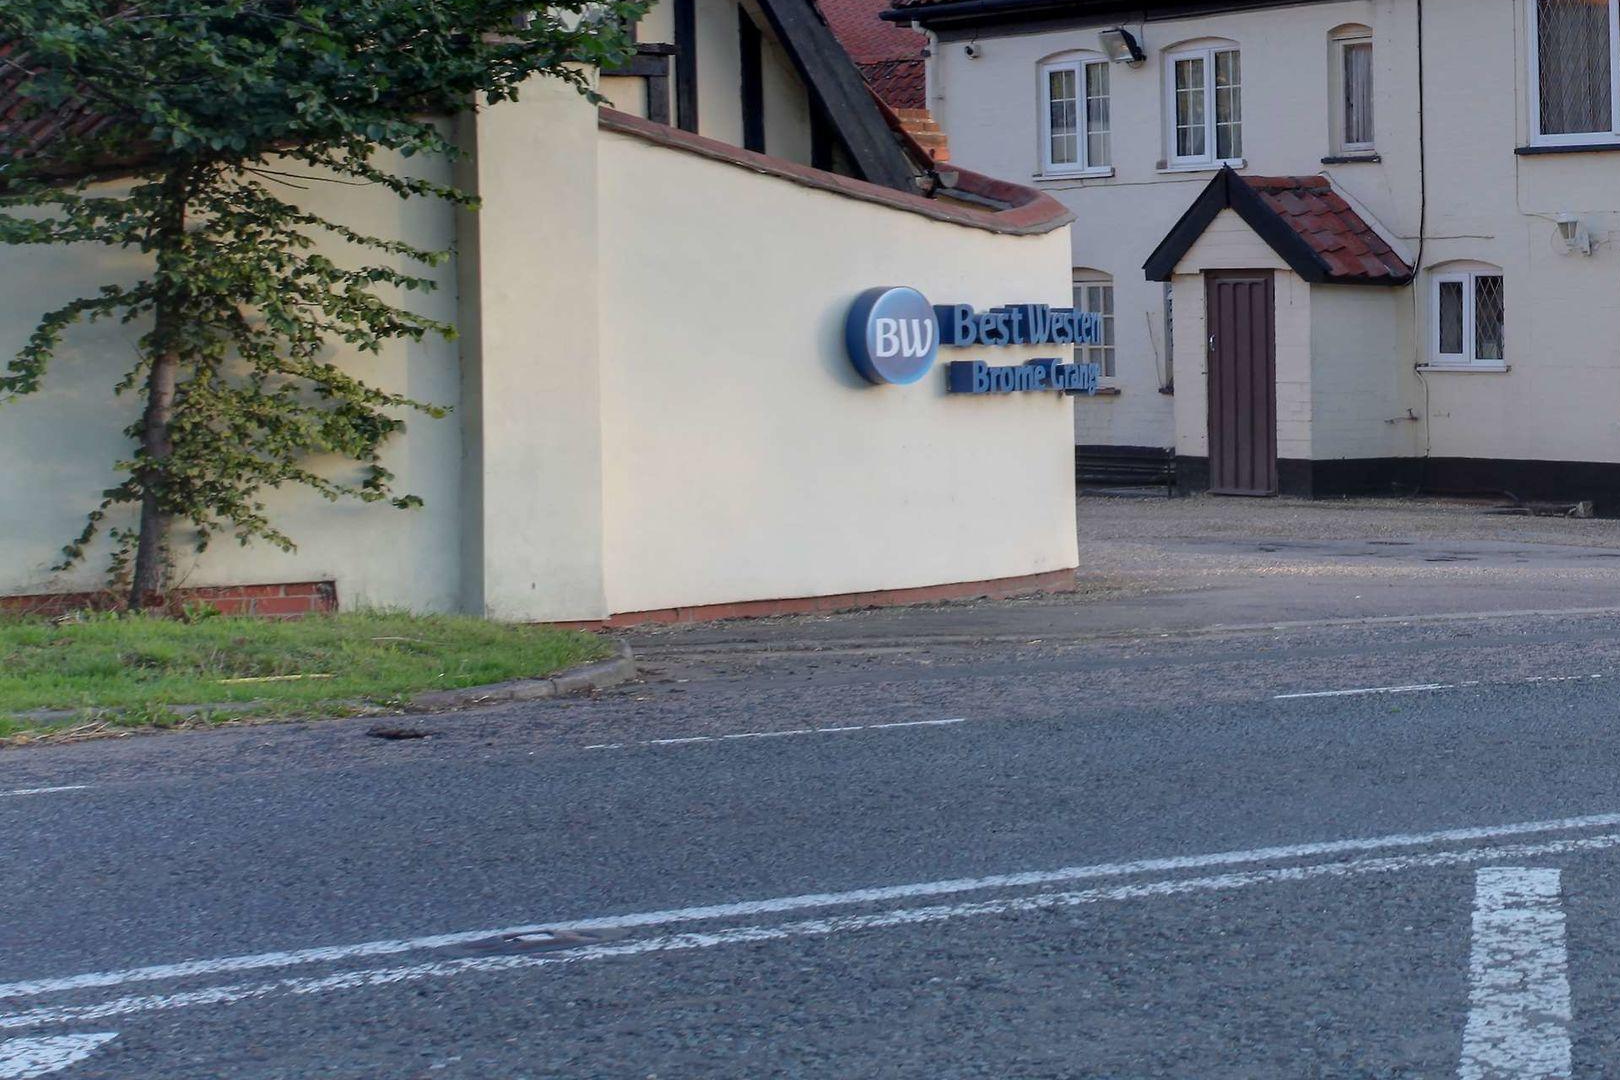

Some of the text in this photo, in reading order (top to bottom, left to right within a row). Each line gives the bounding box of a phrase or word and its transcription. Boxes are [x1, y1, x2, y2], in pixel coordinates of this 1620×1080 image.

[875, 317, 933, 358] BW
[952, 303, 1024, 347] Best
[972, 360, 1047, 393] Brome
